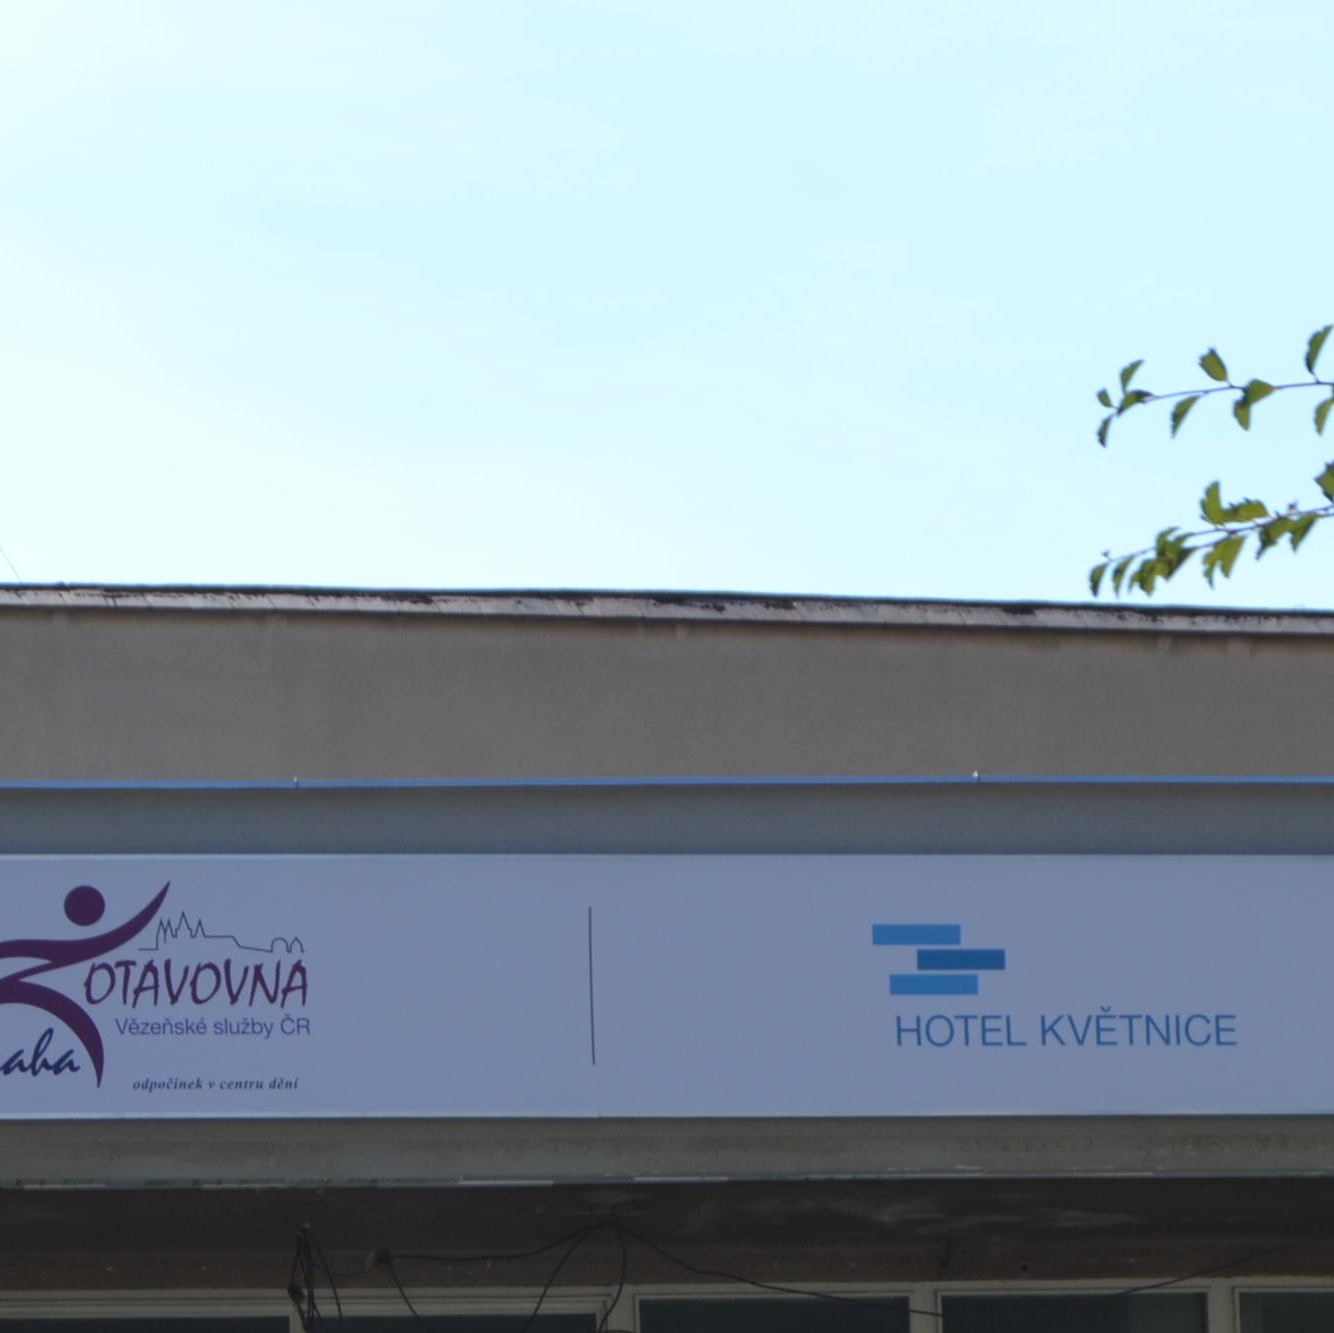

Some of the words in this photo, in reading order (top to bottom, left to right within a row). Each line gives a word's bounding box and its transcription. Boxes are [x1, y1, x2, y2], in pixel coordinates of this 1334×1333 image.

[114, 1015, 208, 1036] Vězeňské
[213, 1015, 274, 1039] služby
[280, 1014, 311, 1036] ČR
[896, 1014, 1028, 1047] HOTEL
[1040, 1005, 1238, 1047] KVĚTNICE
[132, 1077, 203, 1093] odpočinek
[208, 1081, 217, 1090] v
[219, 1080, 264, 1091] centru
